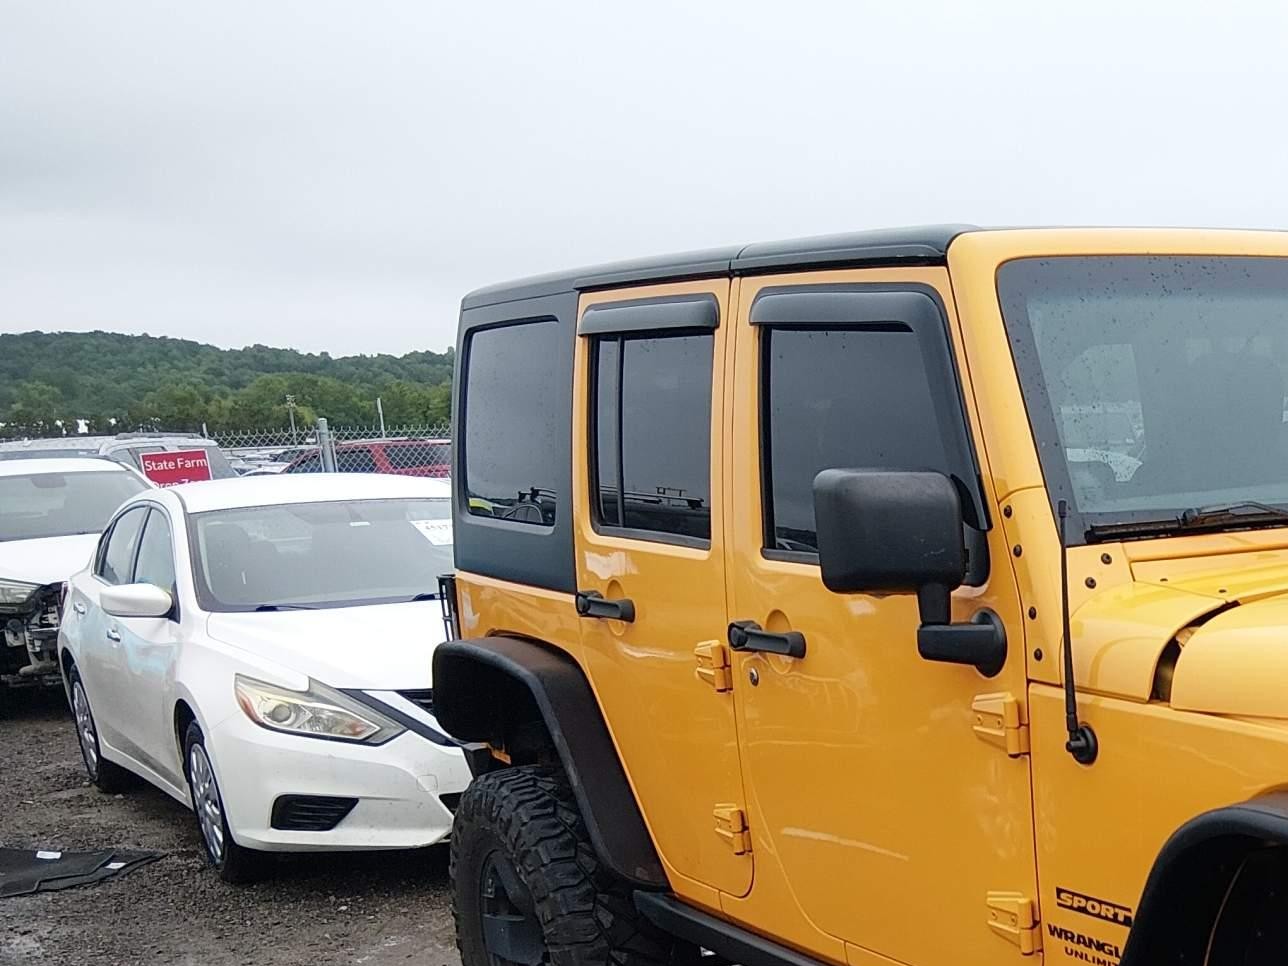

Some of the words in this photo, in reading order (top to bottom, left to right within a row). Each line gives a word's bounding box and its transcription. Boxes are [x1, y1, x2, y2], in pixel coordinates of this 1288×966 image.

[145, 460, 175, 471] State
[177, 458, 208, 469] Farm
[1058, 892, 1128, 923] SPORT
